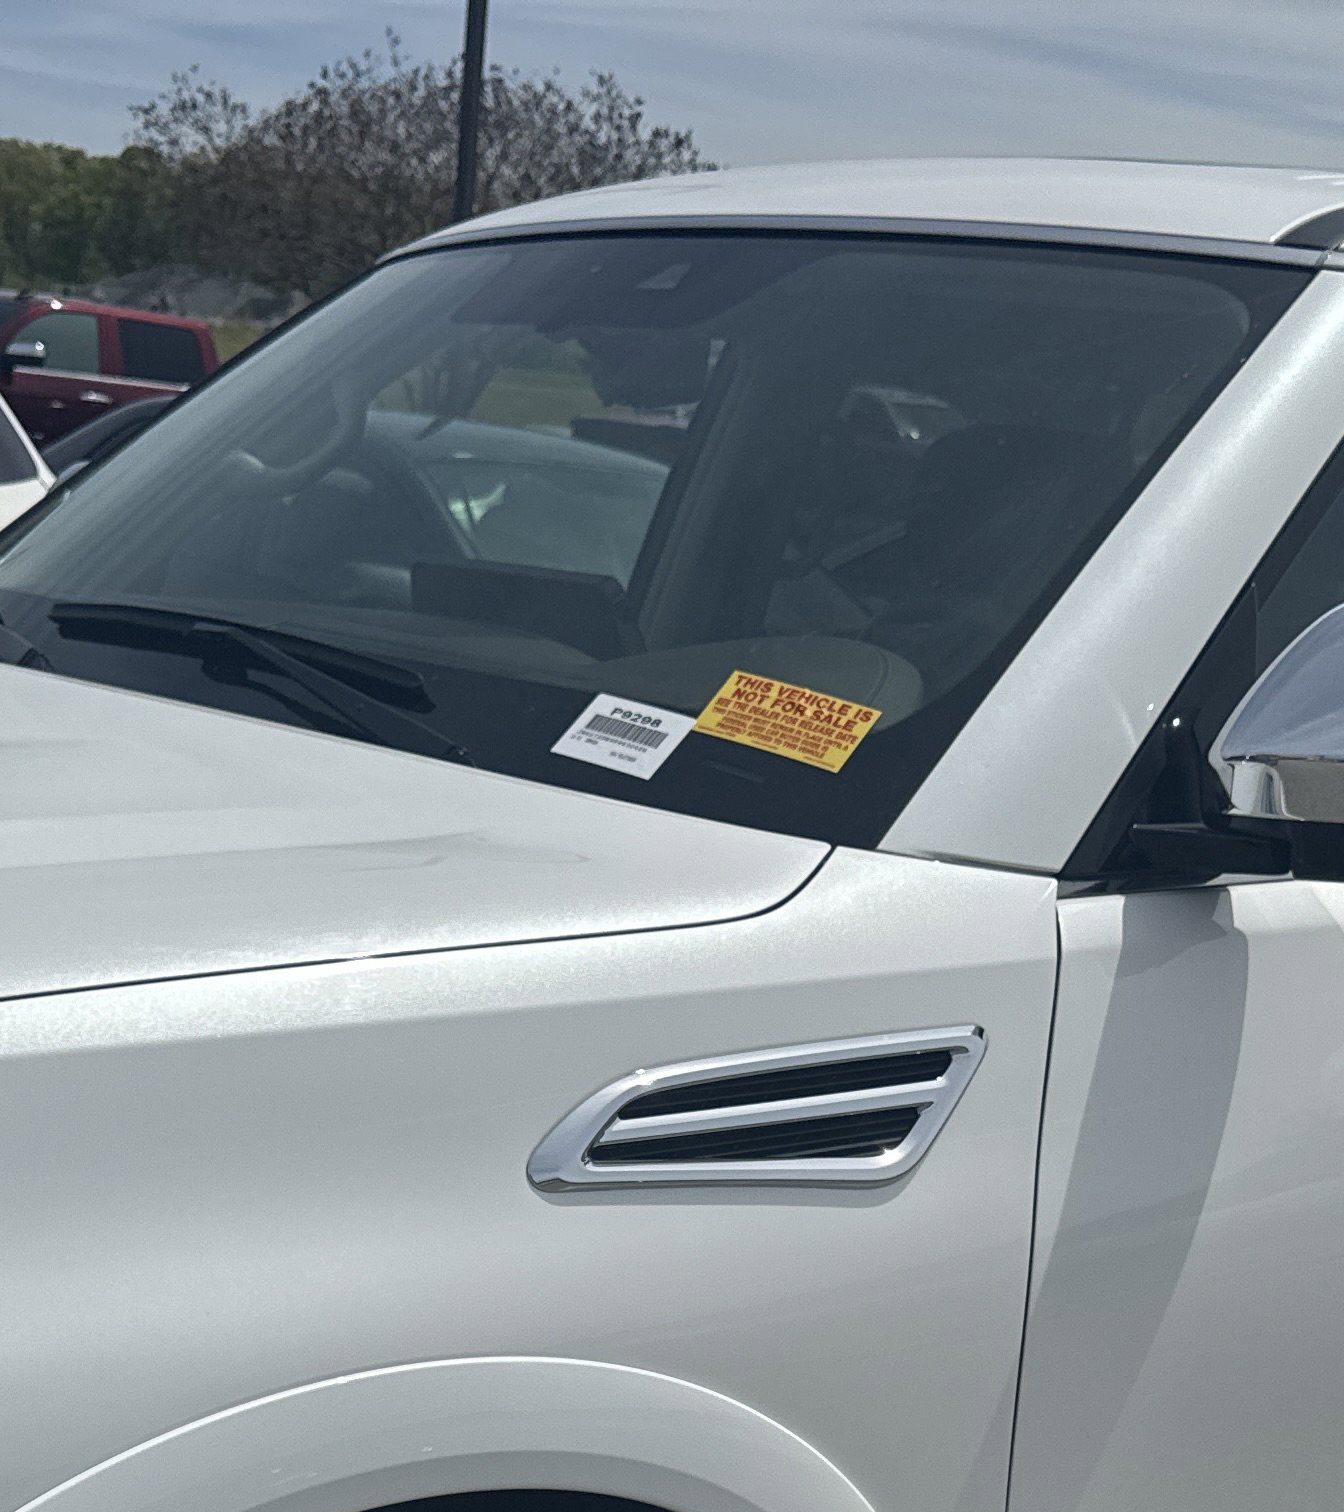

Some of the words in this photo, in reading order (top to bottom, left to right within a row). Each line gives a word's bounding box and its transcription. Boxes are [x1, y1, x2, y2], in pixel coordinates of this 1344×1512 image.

[731, 688, 769, 705] NOT
[770, 698, 807, 717] FOR
[810, 710, 858, 732] SALE
[735, 674, 774, 693] THIS
[777, 685, 852, 716] VEHICLE
[854, 708, 873, 722] IS
[732, 701, 750, 712] THE
[748, 705, 781, 721] DEALER
[780, 714, 799, 726] FOR
[798, 720, 836, 737] RELEASE
[835, 731, 859, 745] DATE
